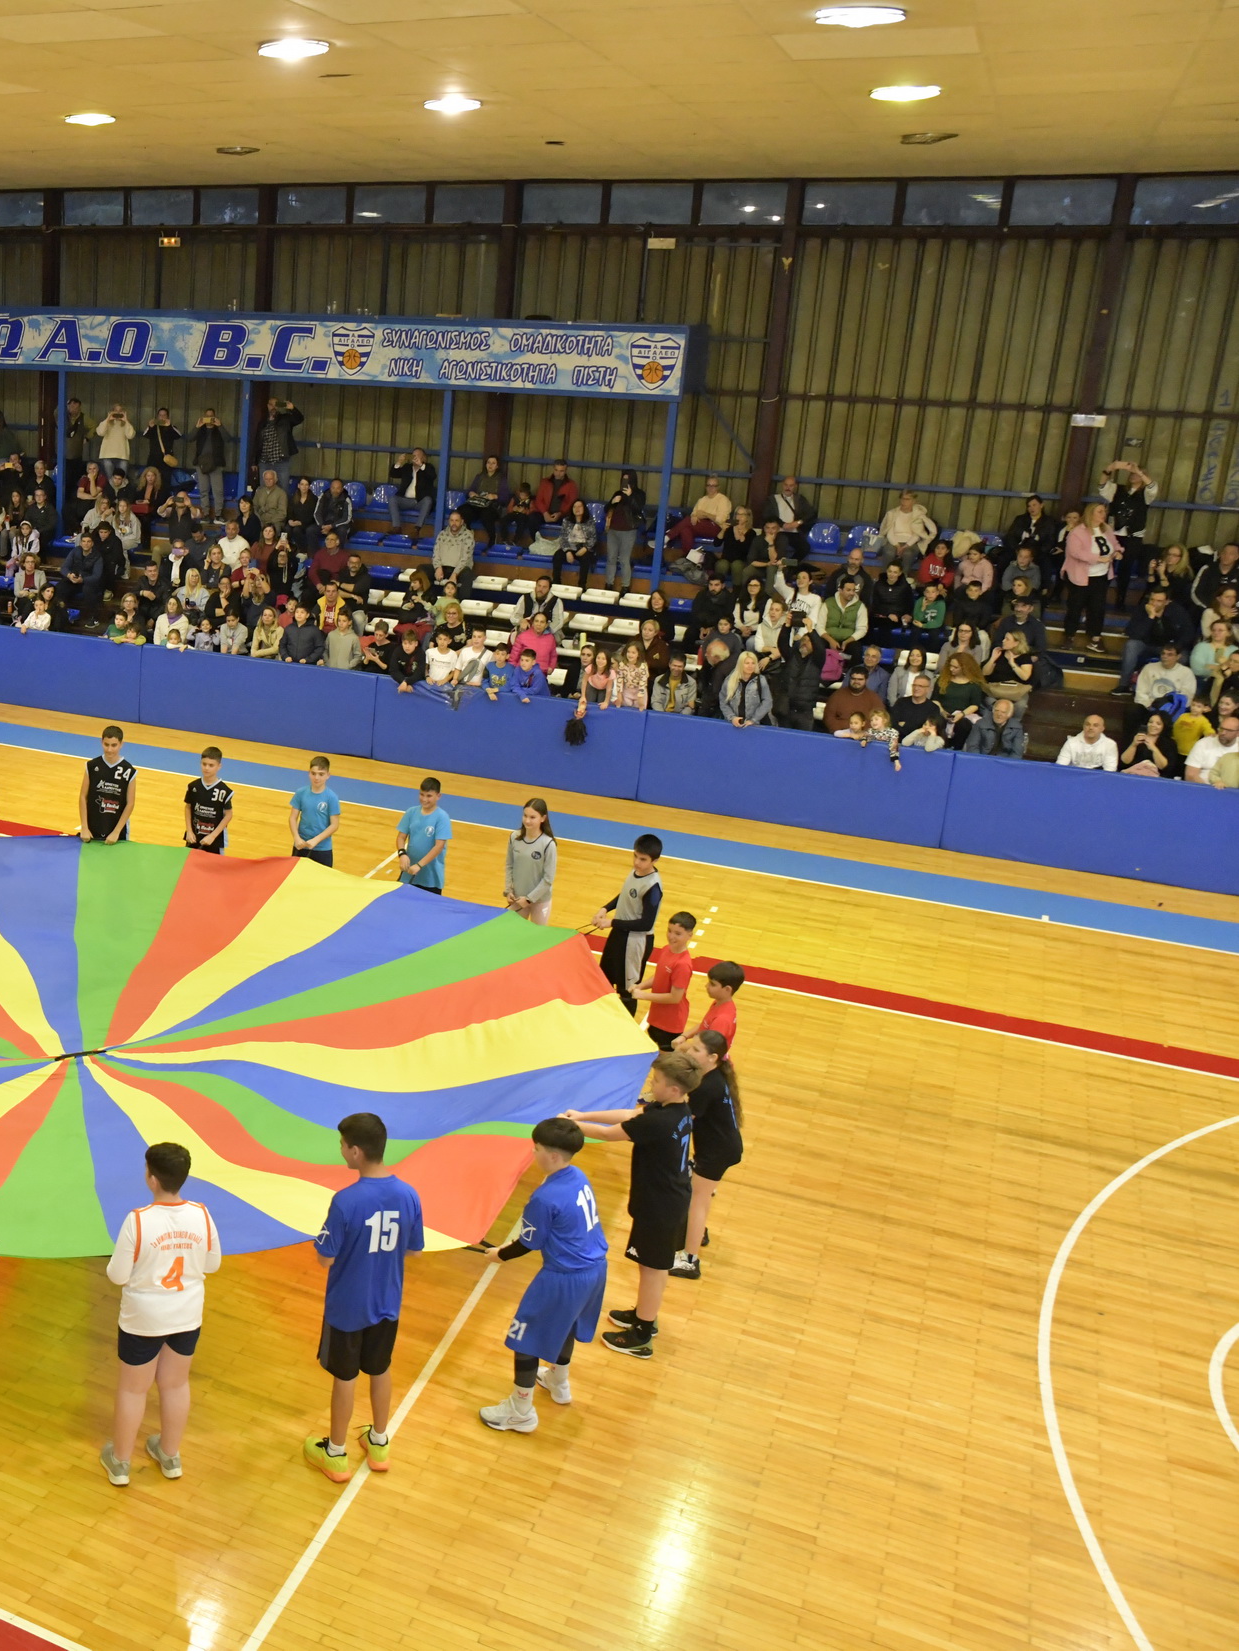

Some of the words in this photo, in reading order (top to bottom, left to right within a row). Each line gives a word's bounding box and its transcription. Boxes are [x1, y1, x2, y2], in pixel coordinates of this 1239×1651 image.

[193, 321, 331, 374] B.C.
[381, 328, 491, 351] ΣΥΝΑΓΩΝΙΣΜΟΣ
[510, 332, 614, 357] ΟΜΑΔΙΚΟΤΗΤΑ
[388, 357, 424, 379] ΝΙΚΗ
[438, 358, 557, 385] ΑΓΩΝΙΣΤΙΚΟΤΗΤΑ
[572, 365, 618, 389] ΠΙΣΤΗ
[1095, 536, 1110, 556] B
[114, 766, 132, 781] 24
[211, 788, 226, 802] 30
[576, 1184, 599, 1232] 12
[365, 1210, 400, 1253] 15
[161, 1256, 184, 1292] 4
[507, 1318, 528, 1341] 21
